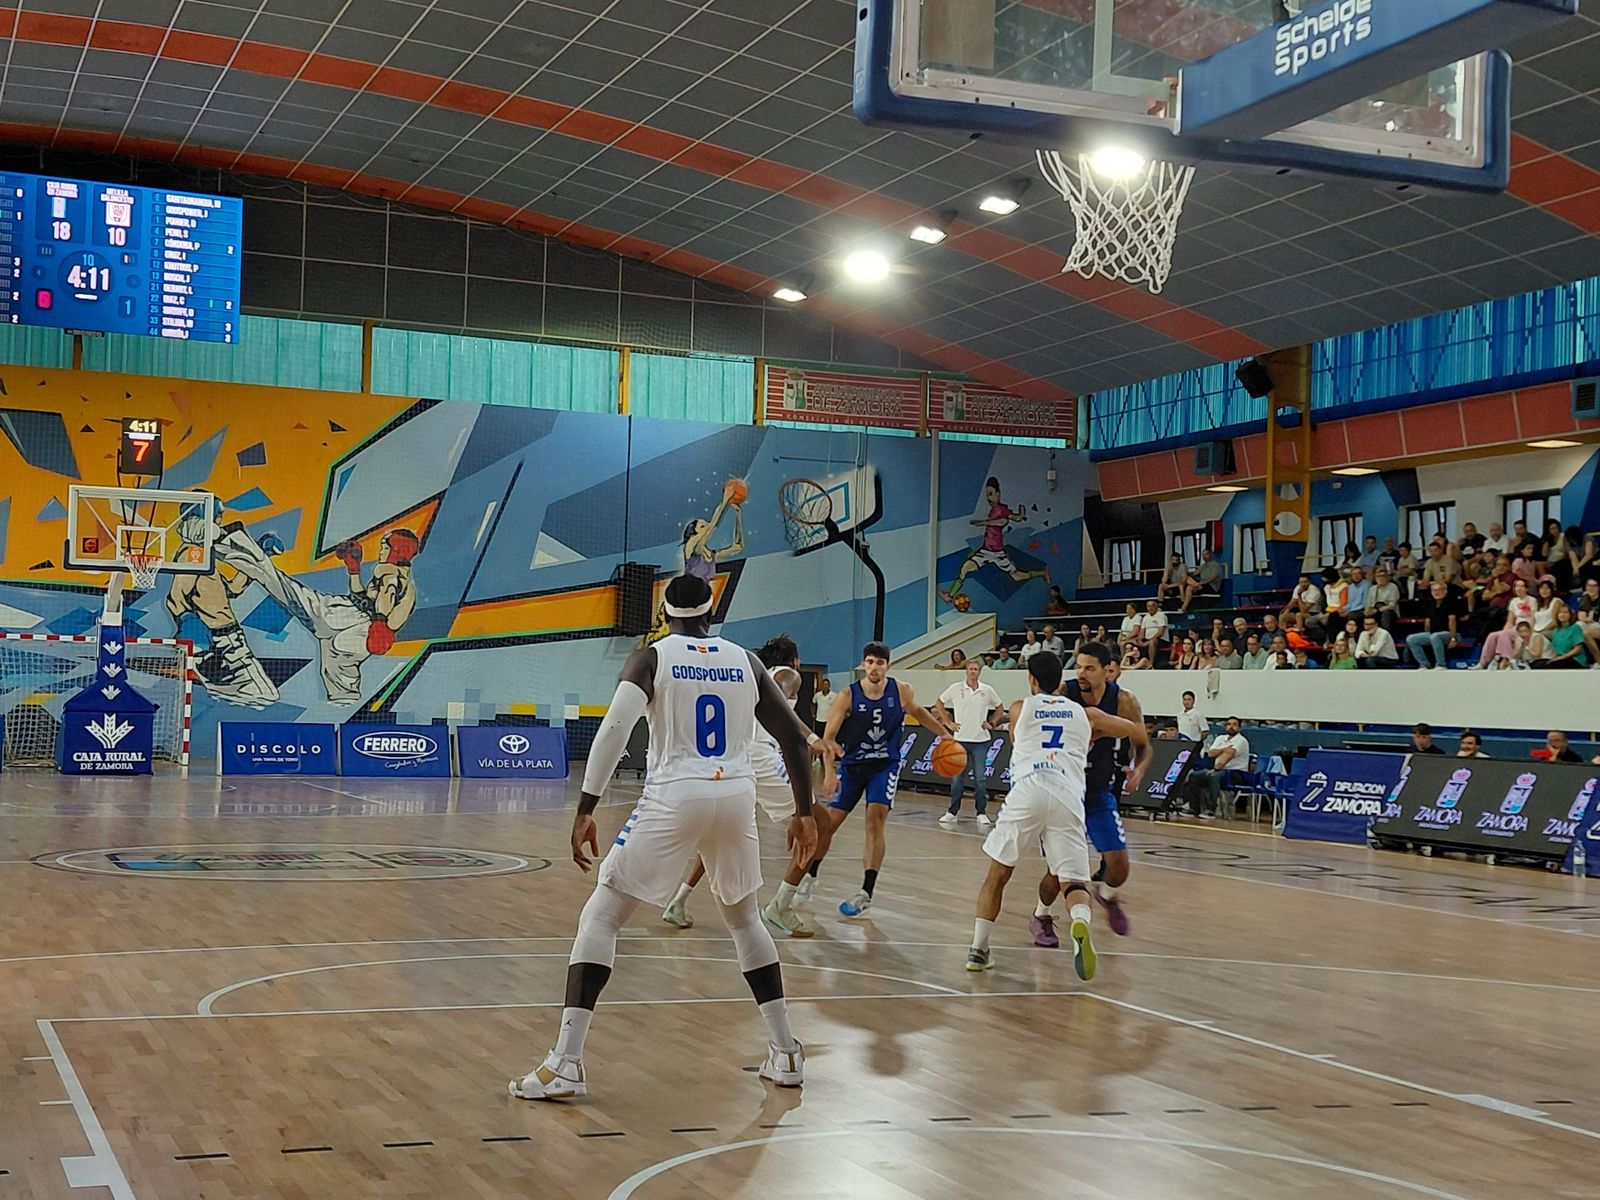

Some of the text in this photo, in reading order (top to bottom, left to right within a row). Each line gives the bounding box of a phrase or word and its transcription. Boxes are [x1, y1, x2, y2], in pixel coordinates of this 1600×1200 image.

[1275, 0, 1372, 51] Schelde
[1274, 16, 1372, 76] Sports
[52, 221, 71, 240] 18
[108, 227, 126, 246] 10
[68, 266, 109, 290] 4:11
[124, 299, 131, 315] 1
[128, 420, 158, 434] 4:11
[132, 440, 150, 462] 7
[671, 665, 744, 684] GODSPOWER
[872, 708, 883, 724] 5
[363, 738, 427, 752] FERRERO
[1040, 725, 1065, 749] 7
[72, 752, 146, 762] CAJA RURAL
[80, 762, 134, 770] DE ZAMORA
[478, 758, 554, 769] VÍA DE LA PLATA
[1322, 796, 1383, 816] ZAMORA
[1413, 805, 1464, 825] ZAMORA
[1476, 811, 1530, 832] ZAMORA
